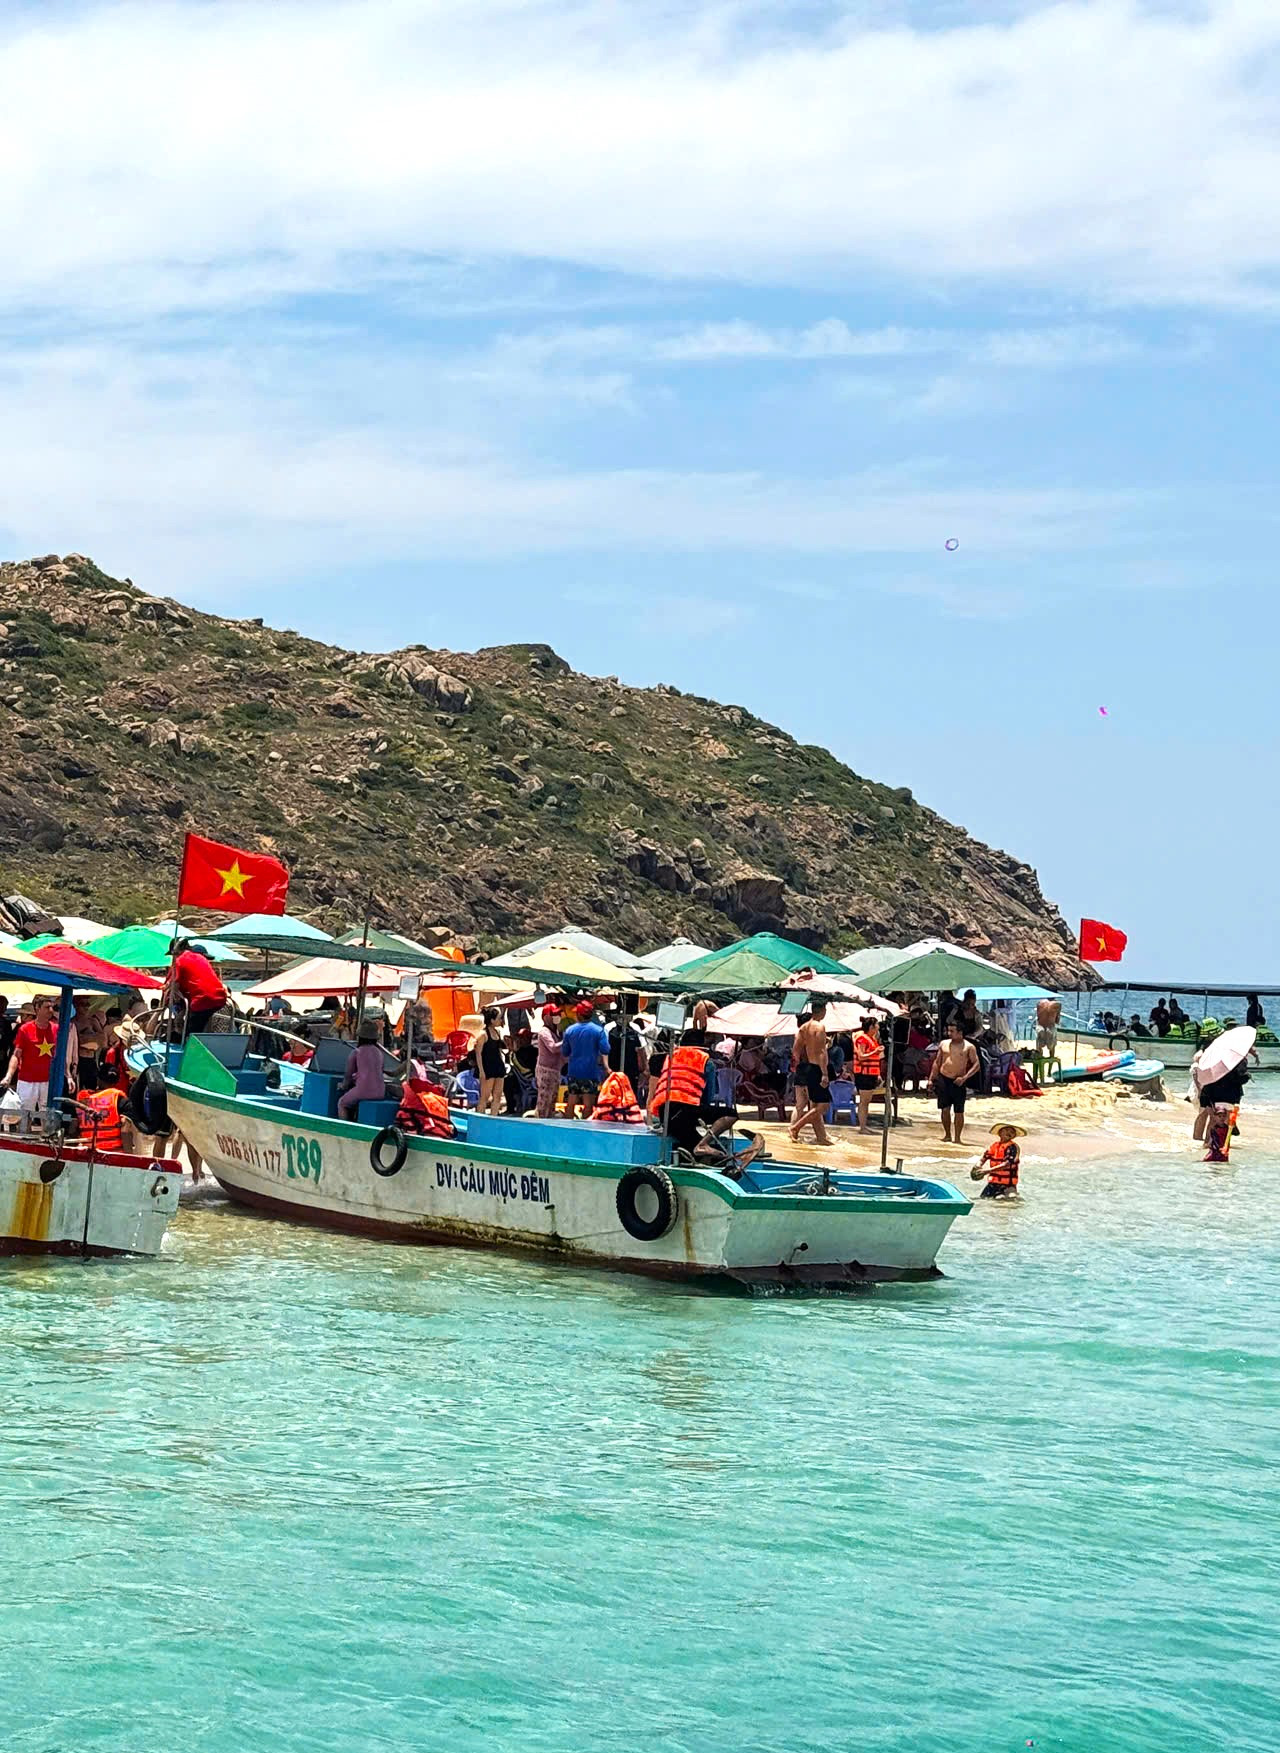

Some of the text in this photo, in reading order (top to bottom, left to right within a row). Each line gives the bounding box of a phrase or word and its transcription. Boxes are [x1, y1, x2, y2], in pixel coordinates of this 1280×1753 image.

[263, 1150, 281, 1177] 177
[282, 1133, 321, 1184] T89
[460, 1162, 485, 1193] CÂU
[489, 1168, 517, 1204] MỰC
[521, 1170, 550, 1203] ĐÊM
